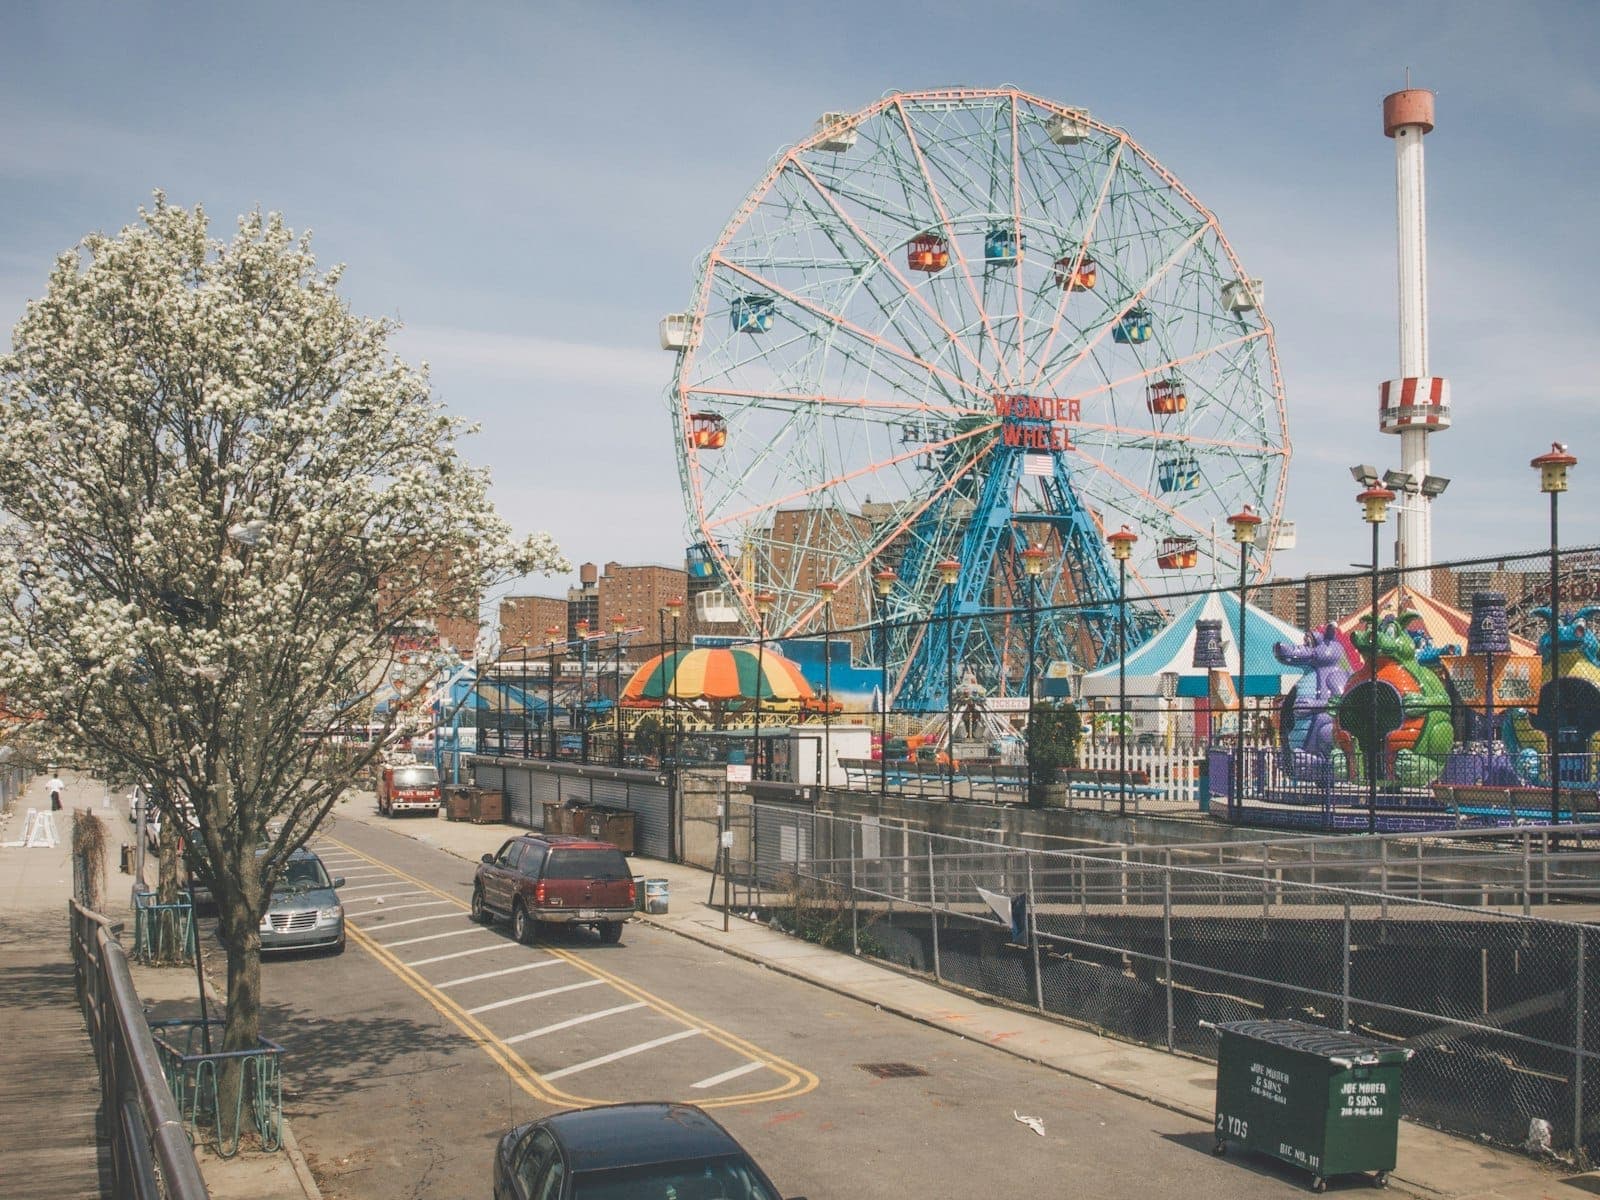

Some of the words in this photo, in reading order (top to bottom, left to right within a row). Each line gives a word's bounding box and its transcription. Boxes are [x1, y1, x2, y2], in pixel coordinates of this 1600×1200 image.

[993, 394, 1080, 422] WONDER
[1002, 423, 1076, 451] WHEEL
[1250, 1063, 1265, 1075] JOE
[1263, 1078, 1282, 1094] SONS
[1340, 1082, 1357, 1094] JOE
[1355, 1095, 1377, 1107] SONS
[1217, 1113, 1224, 1130] 2
[1228, 1115, 1248, 1138] YDS
[1279, 1142, 1293, 1156] BIC
